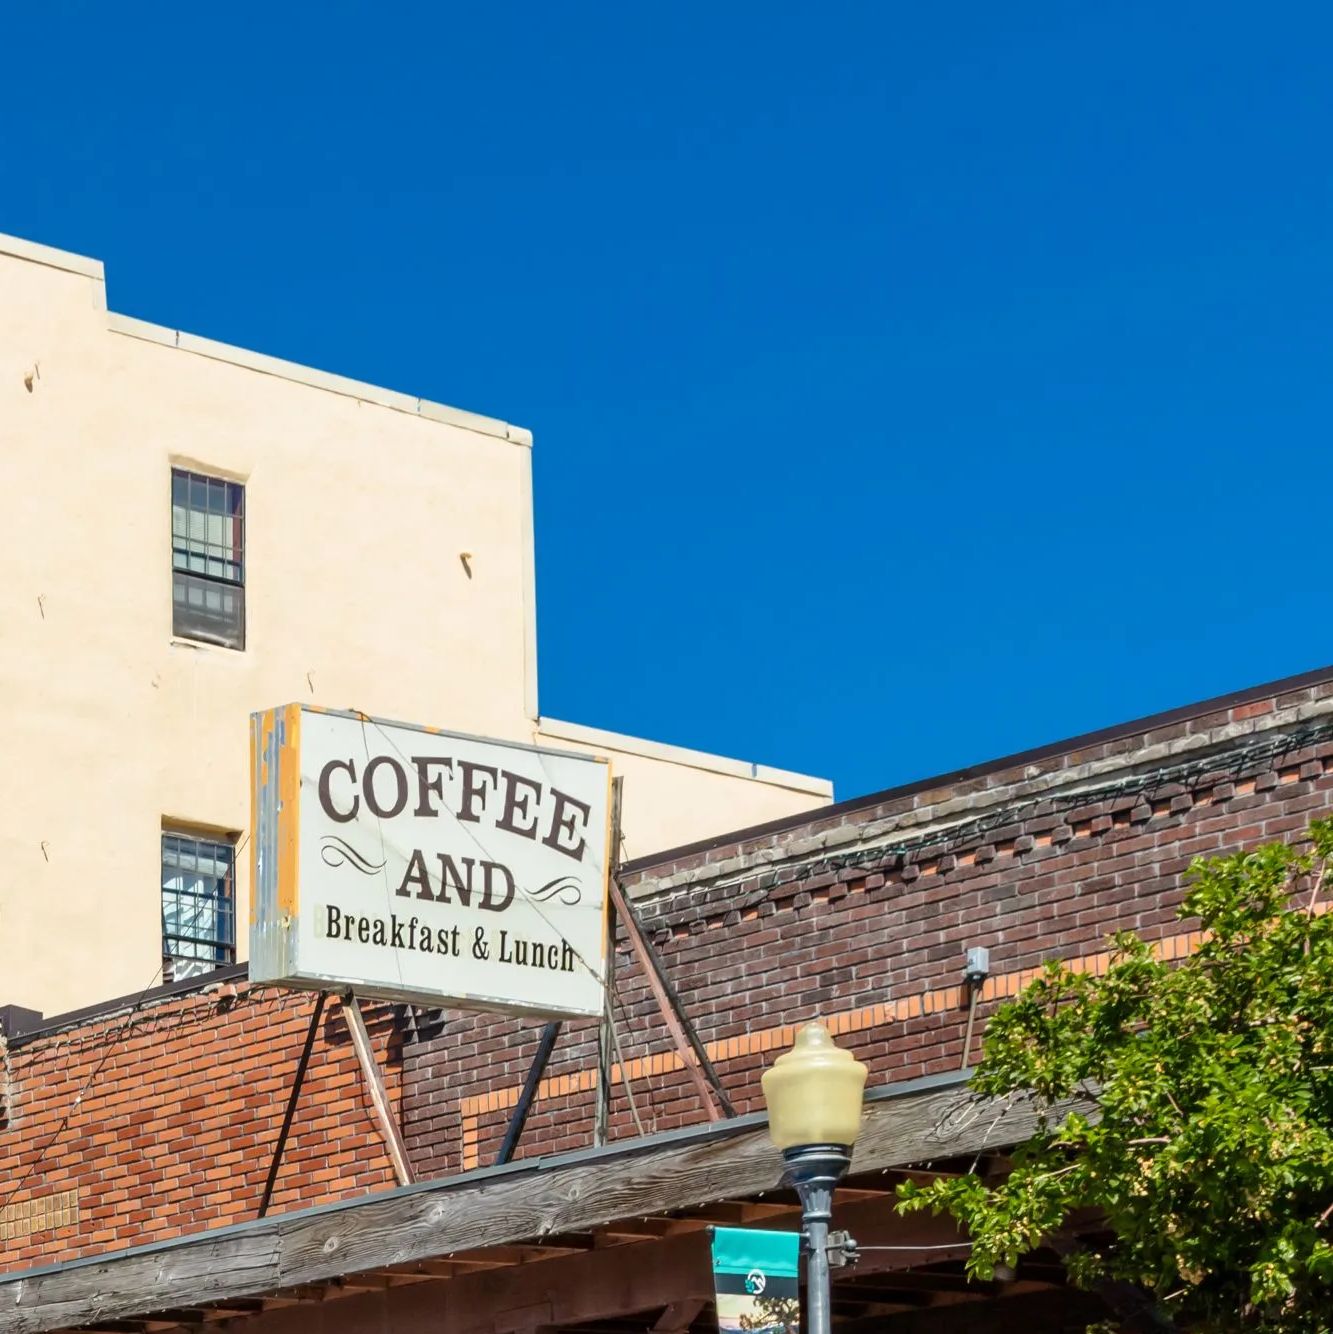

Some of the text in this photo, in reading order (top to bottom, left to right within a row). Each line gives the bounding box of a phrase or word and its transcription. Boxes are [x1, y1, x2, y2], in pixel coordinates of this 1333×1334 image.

[317, 755, 592, 863] COFFEE
[395, 848, 517, 913] AND
[325, 904, 578, 973] Breakfast & Lunch
